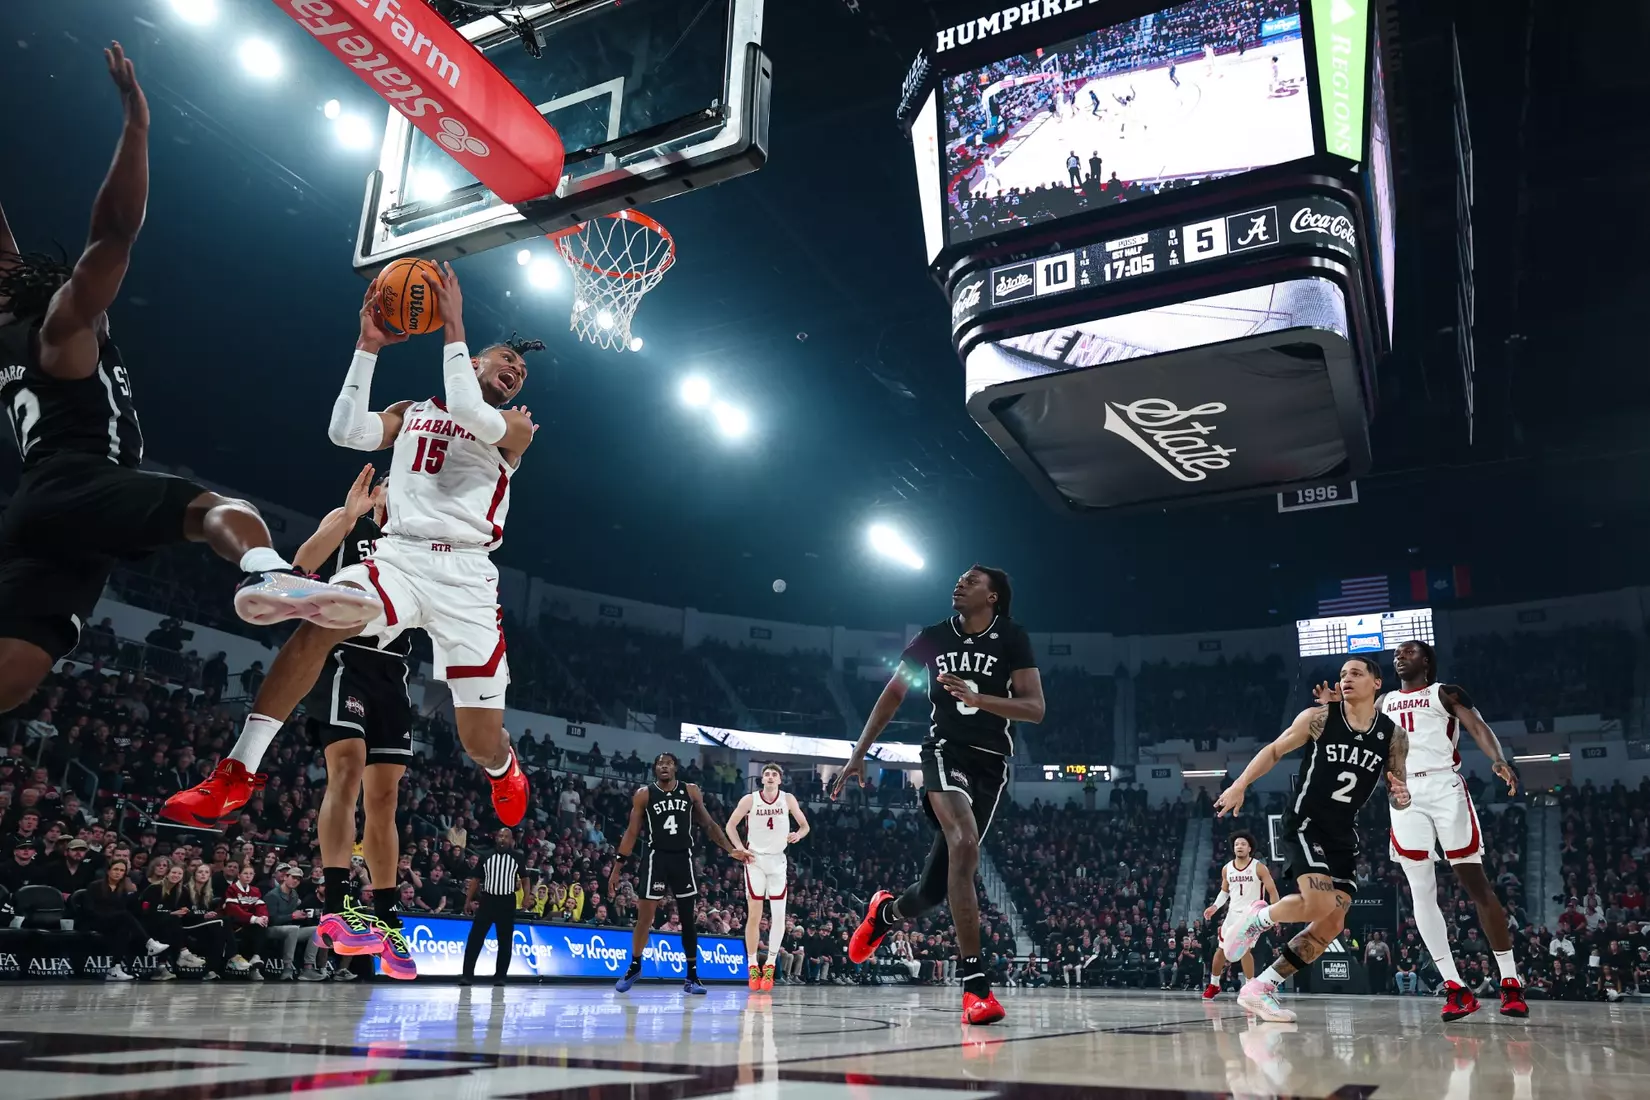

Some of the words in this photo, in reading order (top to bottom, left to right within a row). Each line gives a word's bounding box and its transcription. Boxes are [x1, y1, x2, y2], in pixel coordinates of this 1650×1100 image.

[1331, 32, 1354, 154] REGIONS
[1196, 226, 1214, 253] 5
[1290, 207, 1356, 248] Coca-Cola
[1044, 260, 1068, 287] 10
[1103, 253, 1155, 282] 17:05
[995, 271, 1033, 297] State
[409, 284, 425, 330] Wilson
[1104, 398, 1237, 482] State
[411, 436, 449, 475] 15
[1297, 485, 1338, 504] 1996
[431, 543, 452, 553] RTR
[935, 651, 998, 677] STATE
[1386, 698, 1430, 713] ALABAMA
[1400, 711, 1415, 733] 11
[1201, 740, 1210, 750] N
[1326, 743, 1383, 773] STATE
[1330, 771, 1358, 803] 2
[653, 799, 688, 815] STATE
[755, 808, 784, 816] ALABAMA
[663, 815, 679, 835] 4
[766, 817, 774, 830] 4
[1229, 875, 1254, 883] ALABAMA
[1239, 883, 1244, 896] 1
[406, 925, 464, 963] Kroger
[586, 935, 627, 971] Kroger
[656, 939, 687, 973] Kroge
[28, 957, 73, 970] ALFA
[714, 943, 744, 974] Kroger
